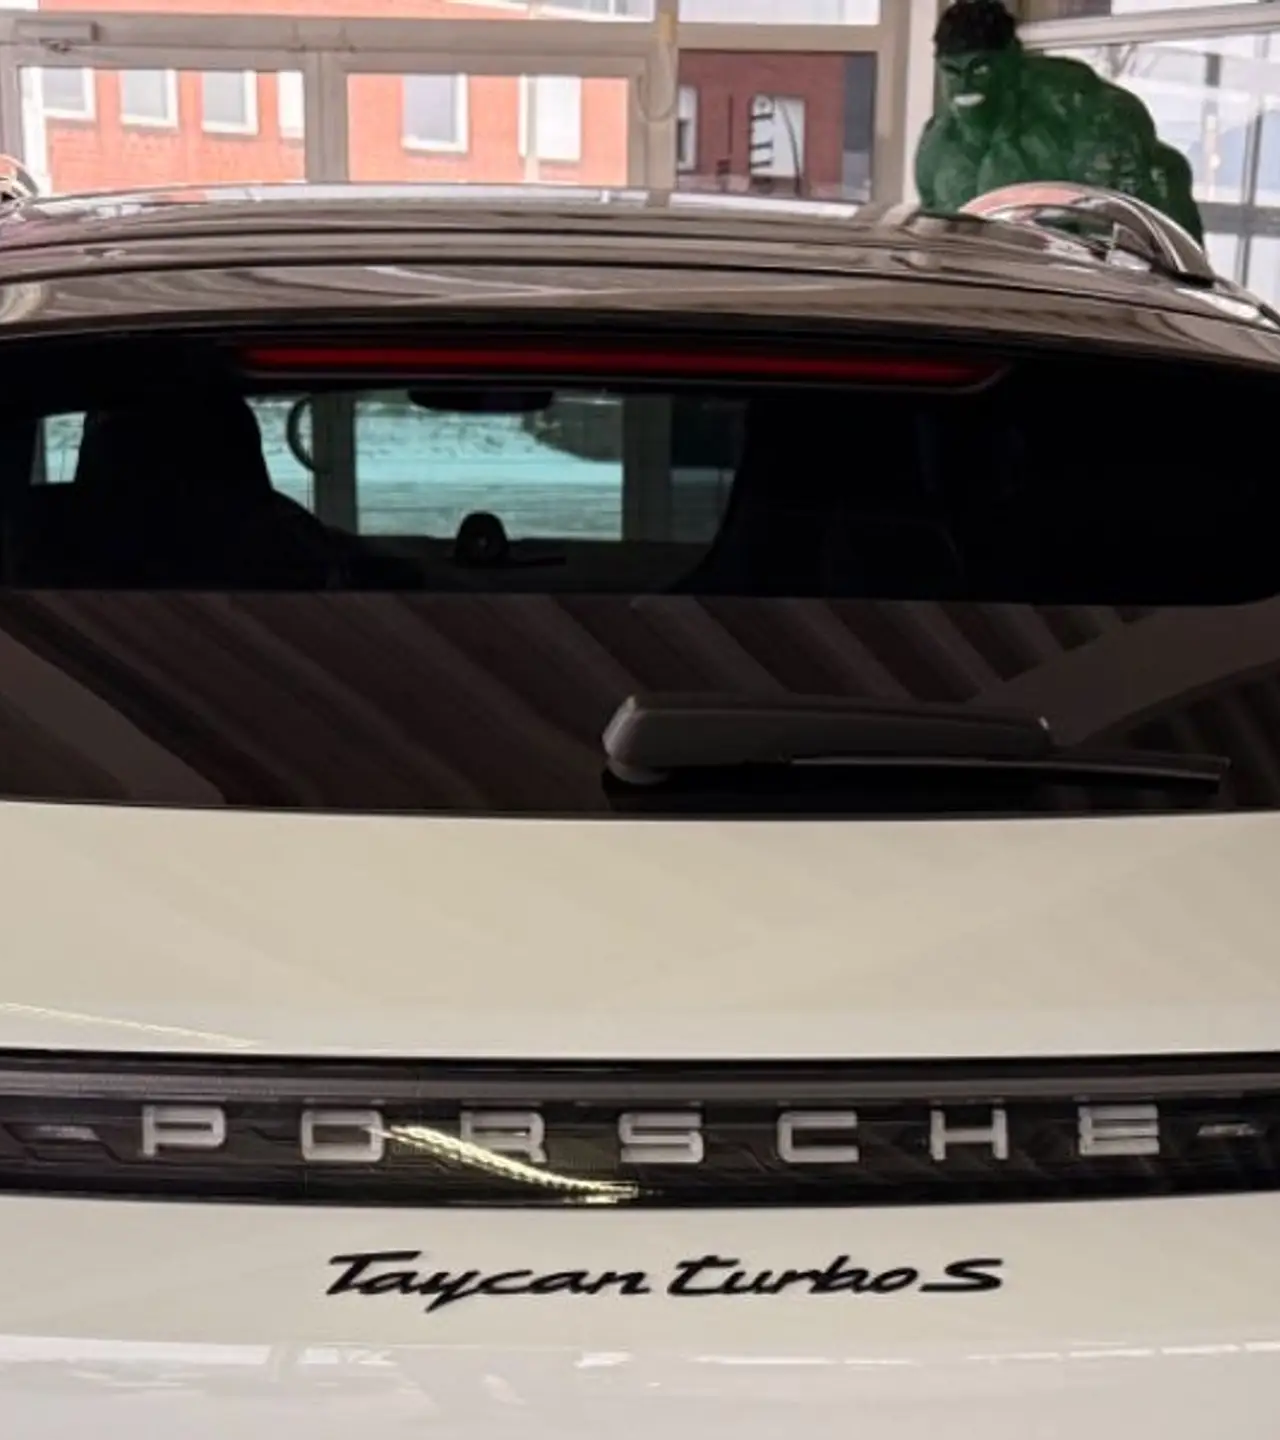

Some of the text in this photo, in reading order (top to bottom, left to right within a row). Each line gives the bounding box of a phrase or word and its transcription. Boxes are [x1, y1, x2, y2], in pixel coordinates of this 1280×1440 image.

[141, 1104, 1160, 1164] PORSCHE
[325, 1250, 1004, 1312] Taycan turbo S
